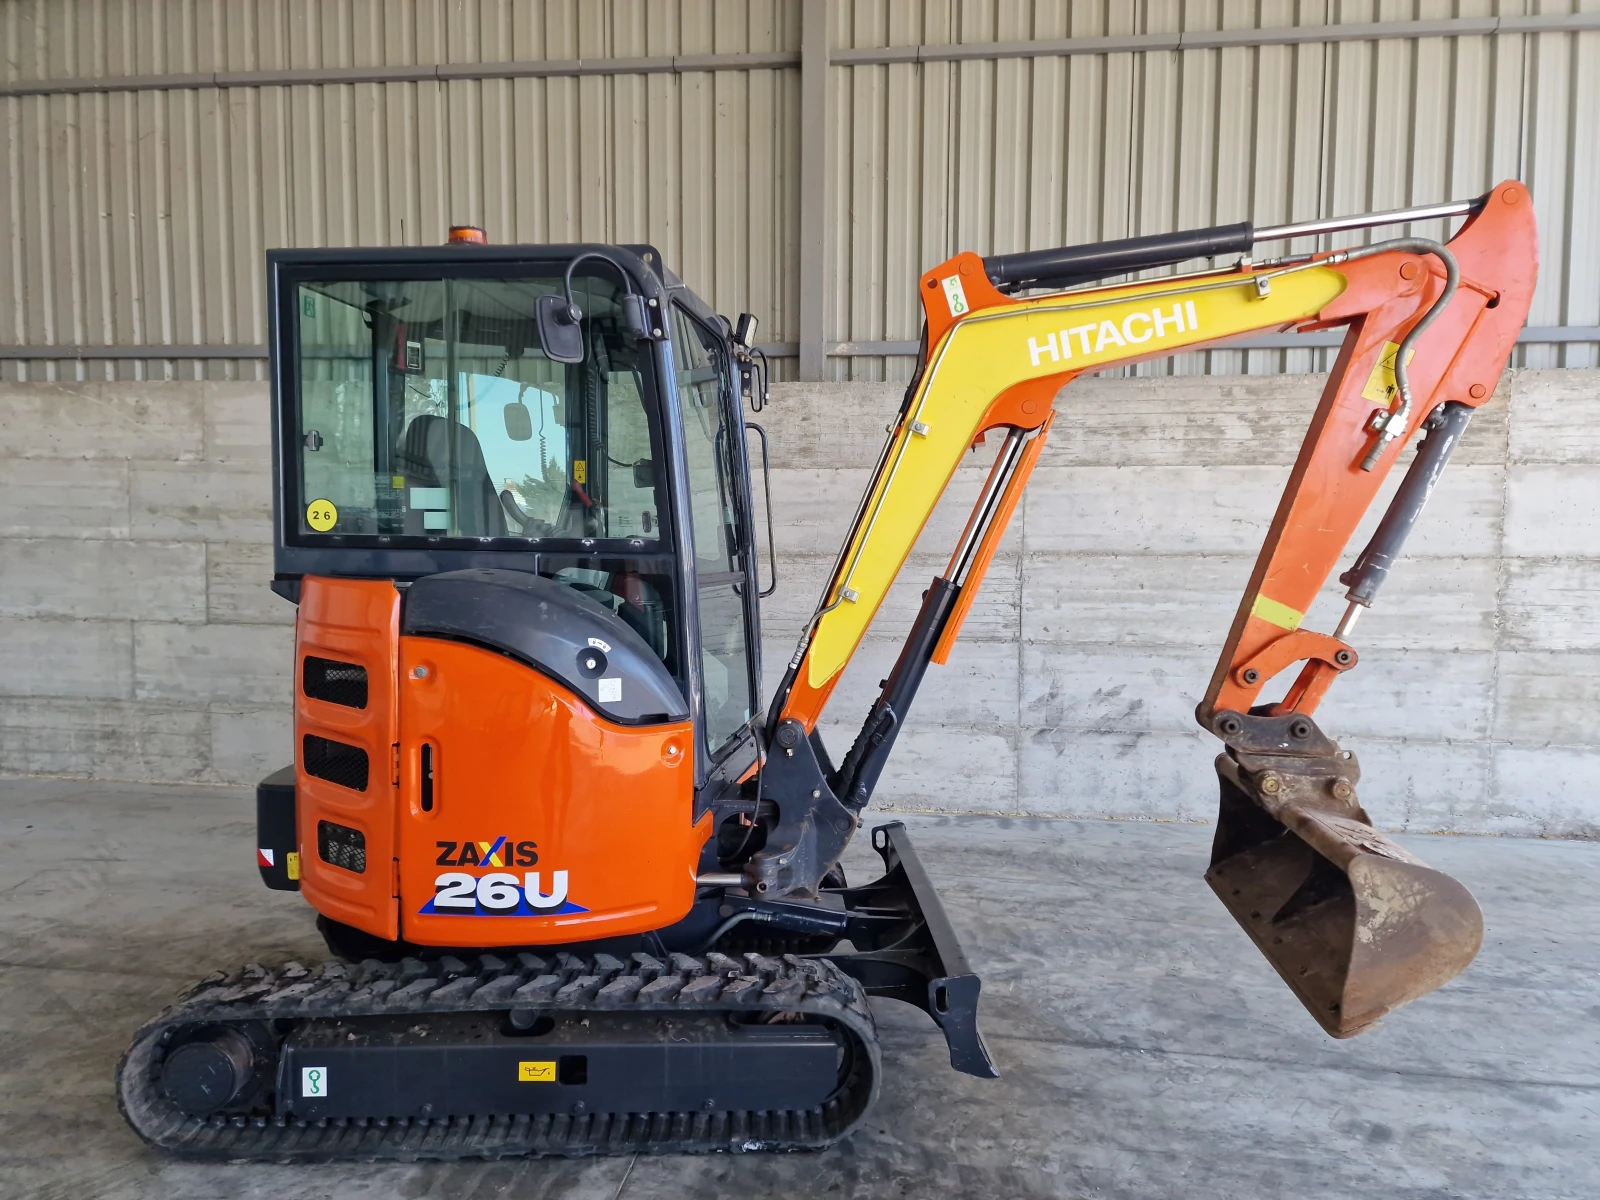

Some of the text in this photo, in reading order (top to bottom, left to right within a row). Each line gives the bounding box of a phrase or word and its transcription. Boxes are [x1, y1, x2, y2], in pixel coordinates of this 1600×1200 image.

[1027, 300, 1198, 366] HITACHI
[435, 836, 539, 867] ZAXIS
[433, 869, 569, 912] 26U
